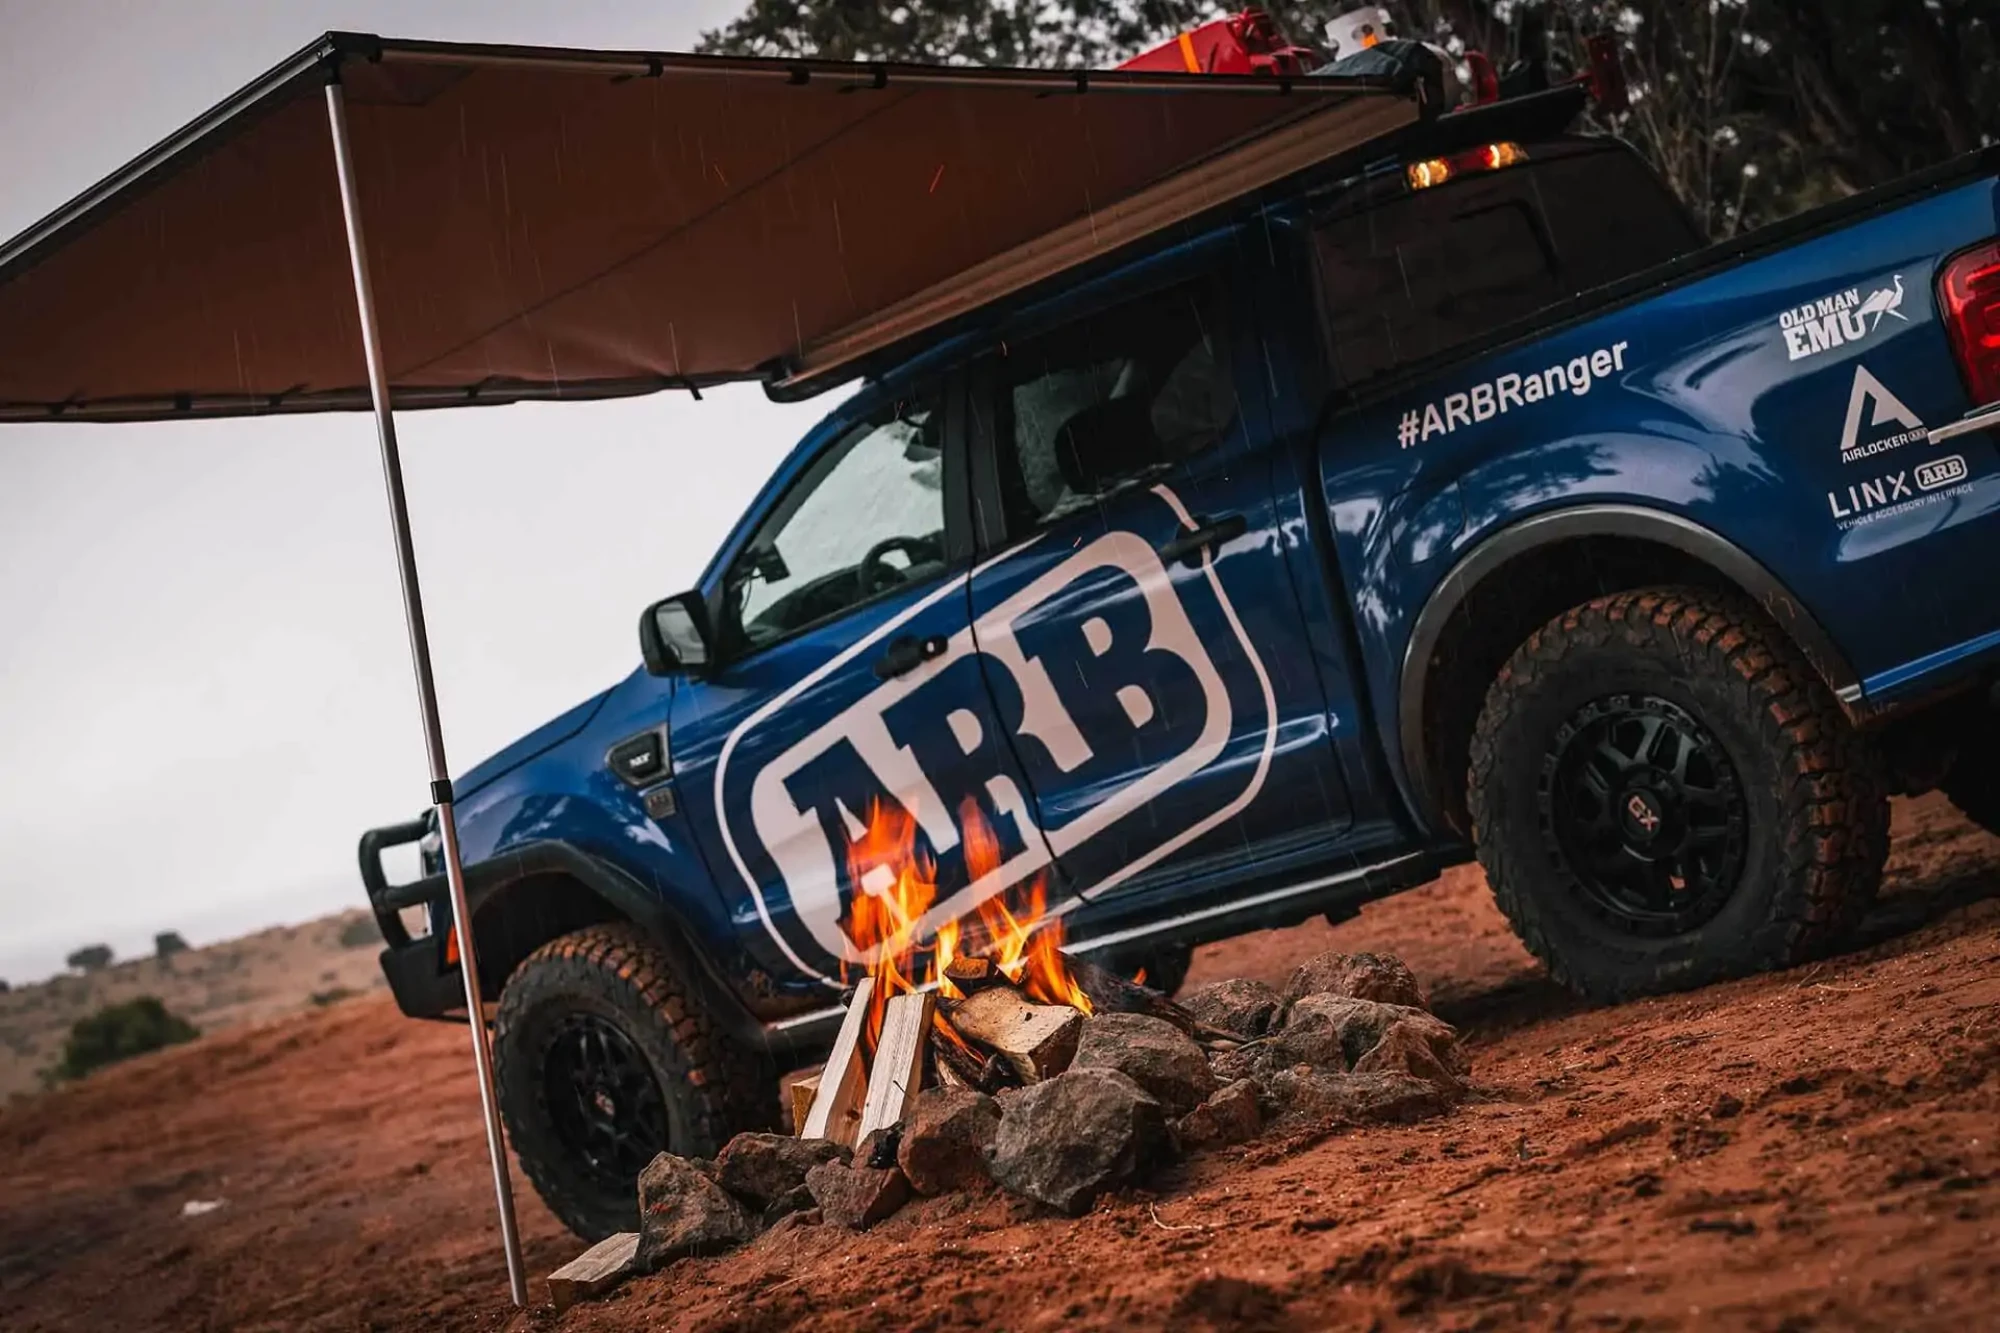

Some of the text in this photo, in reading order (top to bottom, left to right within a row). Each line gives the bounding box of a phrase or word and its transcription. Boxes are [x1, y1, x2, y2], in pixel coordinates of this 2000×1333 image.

[1779, 288, 1861, 329] OLD MAN
[1782, 308, 1866, 361] EMU
[1397, 340, 1628, 449] #ARBRanger
[1841, 433, 1909, 463] AIRLOCKER
[1828, 459, 1964, 519] LINX ARB
[780, 564, 1209, 955] ARB
